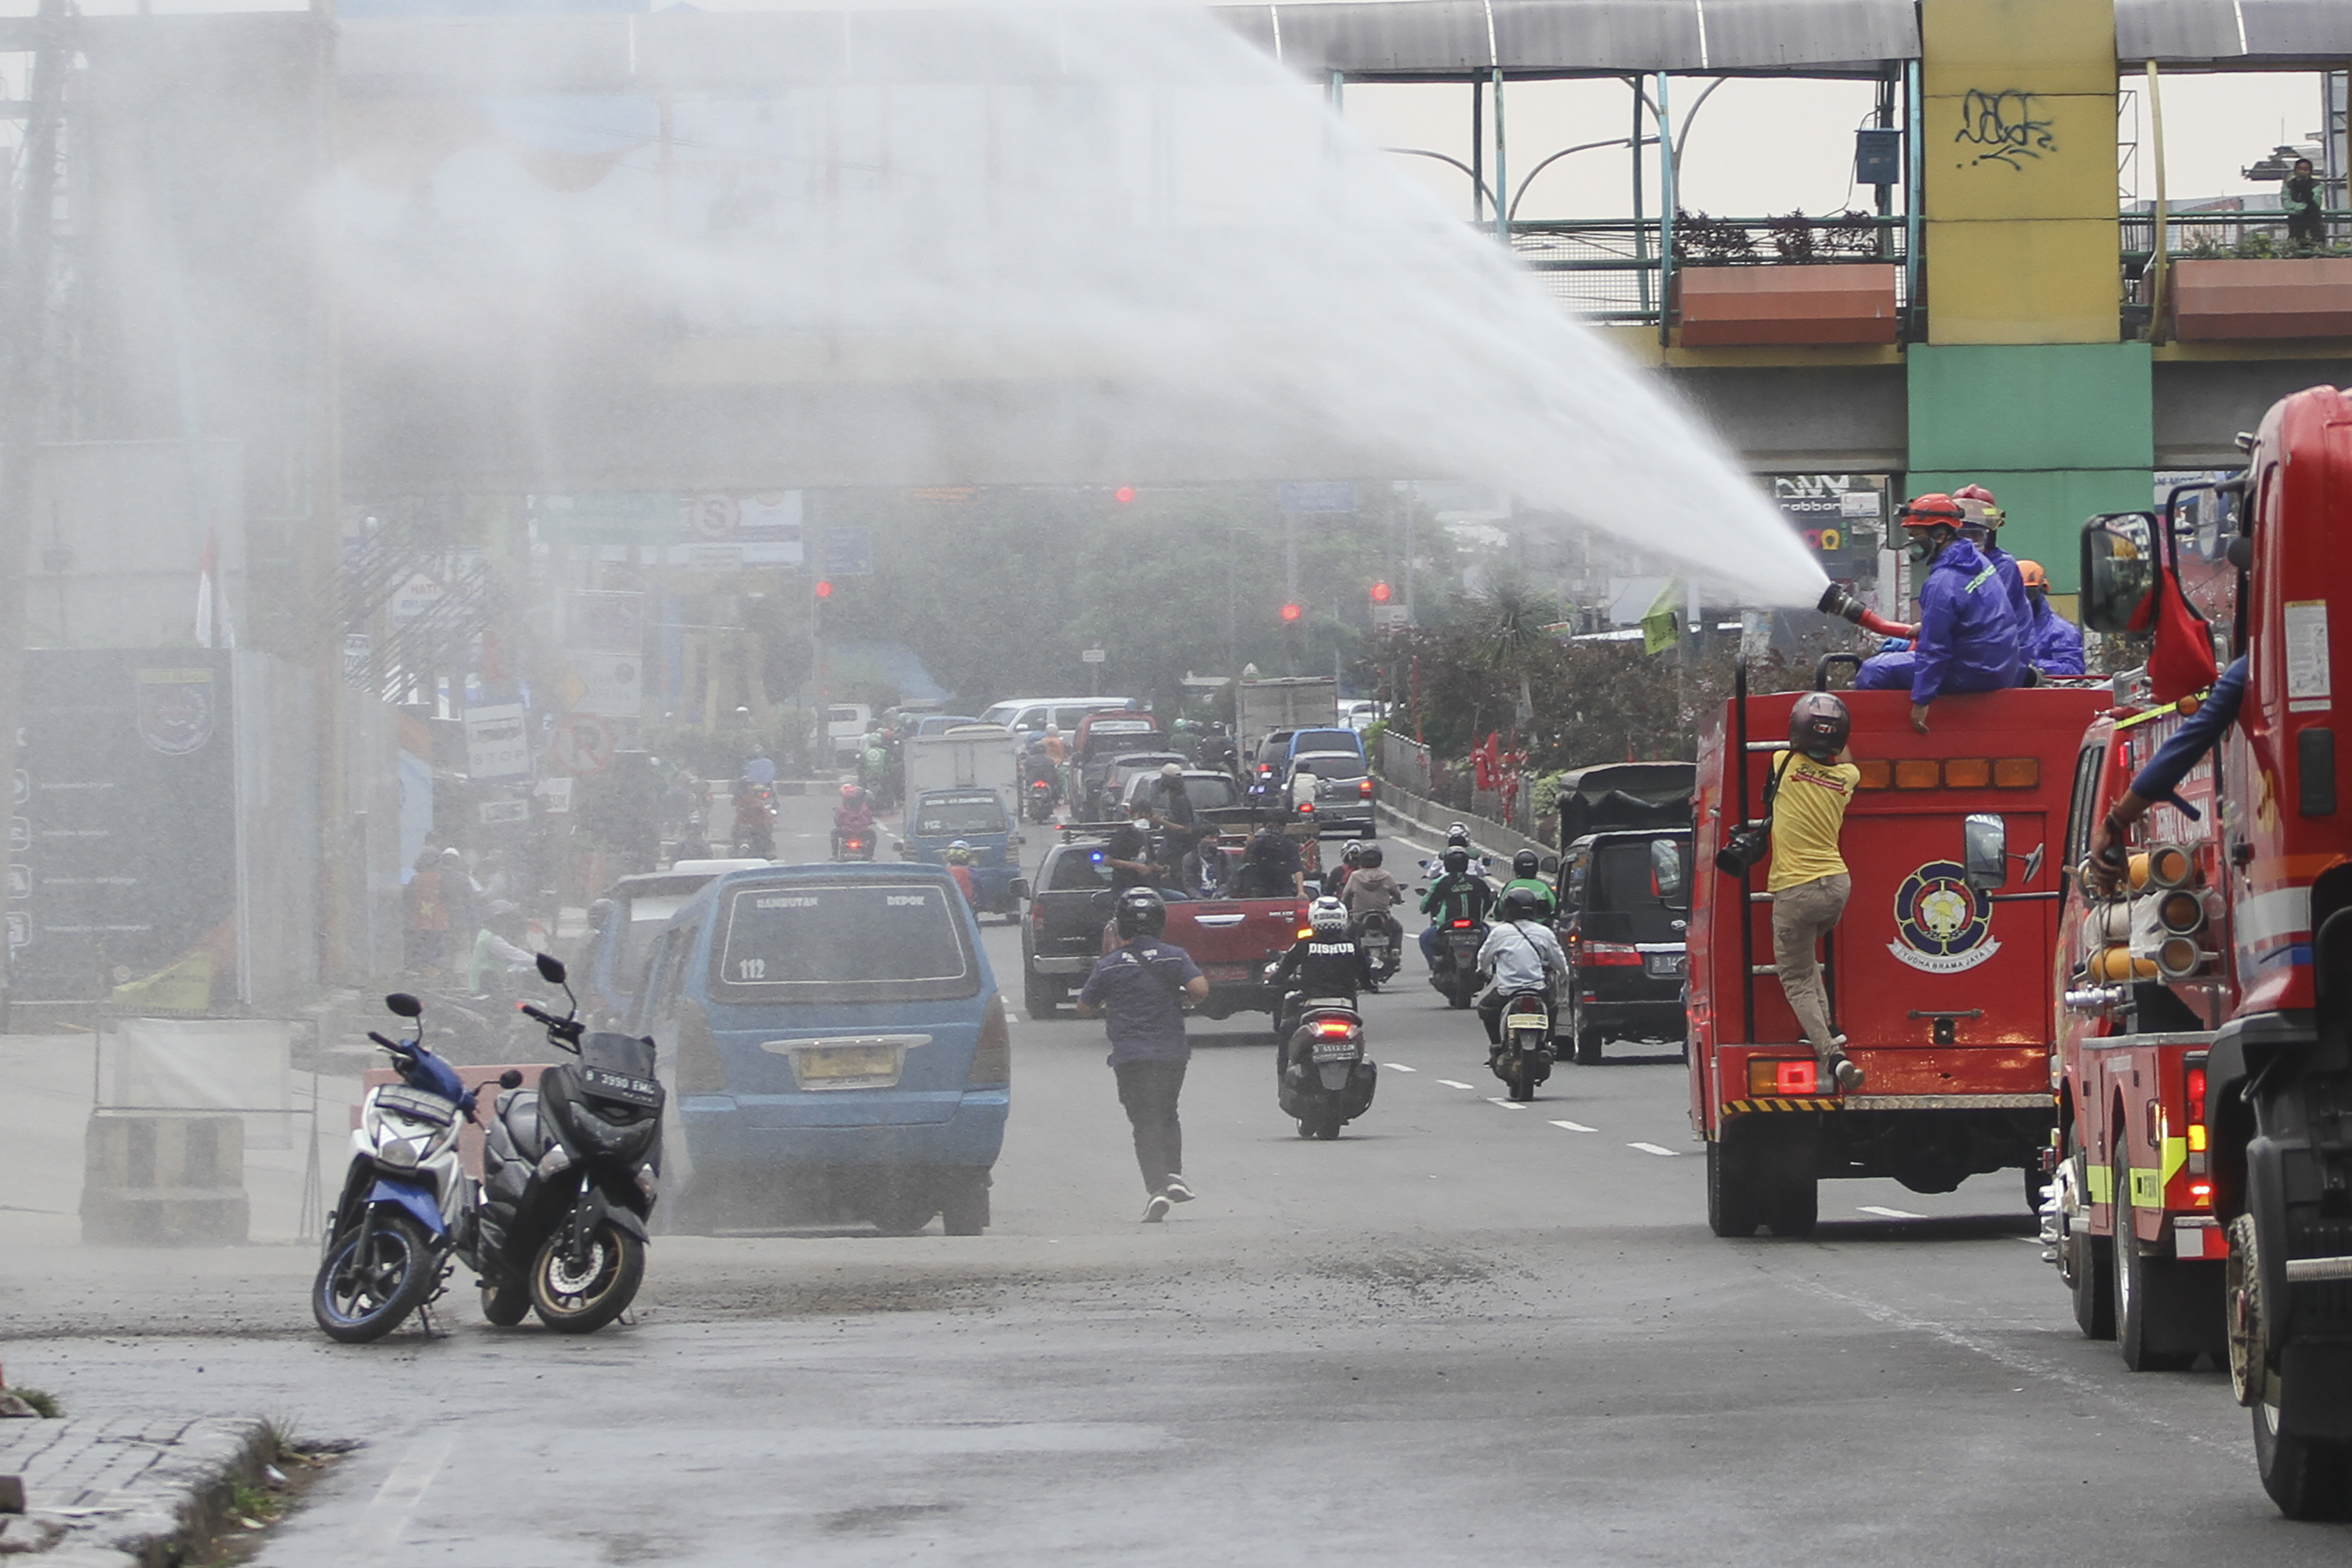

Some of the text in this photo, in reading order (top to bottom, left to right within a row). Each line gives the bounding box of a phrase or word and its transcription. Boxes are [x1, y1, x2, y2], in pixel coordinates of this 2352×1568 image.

[473, 749, 524, 765] STOP
[757, 897, 818, 908] RAMBUTAN
[887, 895, 925, 906] DEPOK
[1308, 942, 1355, 955] DISHUB
[1903, 951, 1985, 969] YUDHA BRAMA JAYA
[739, 958, 766, 979] 112
